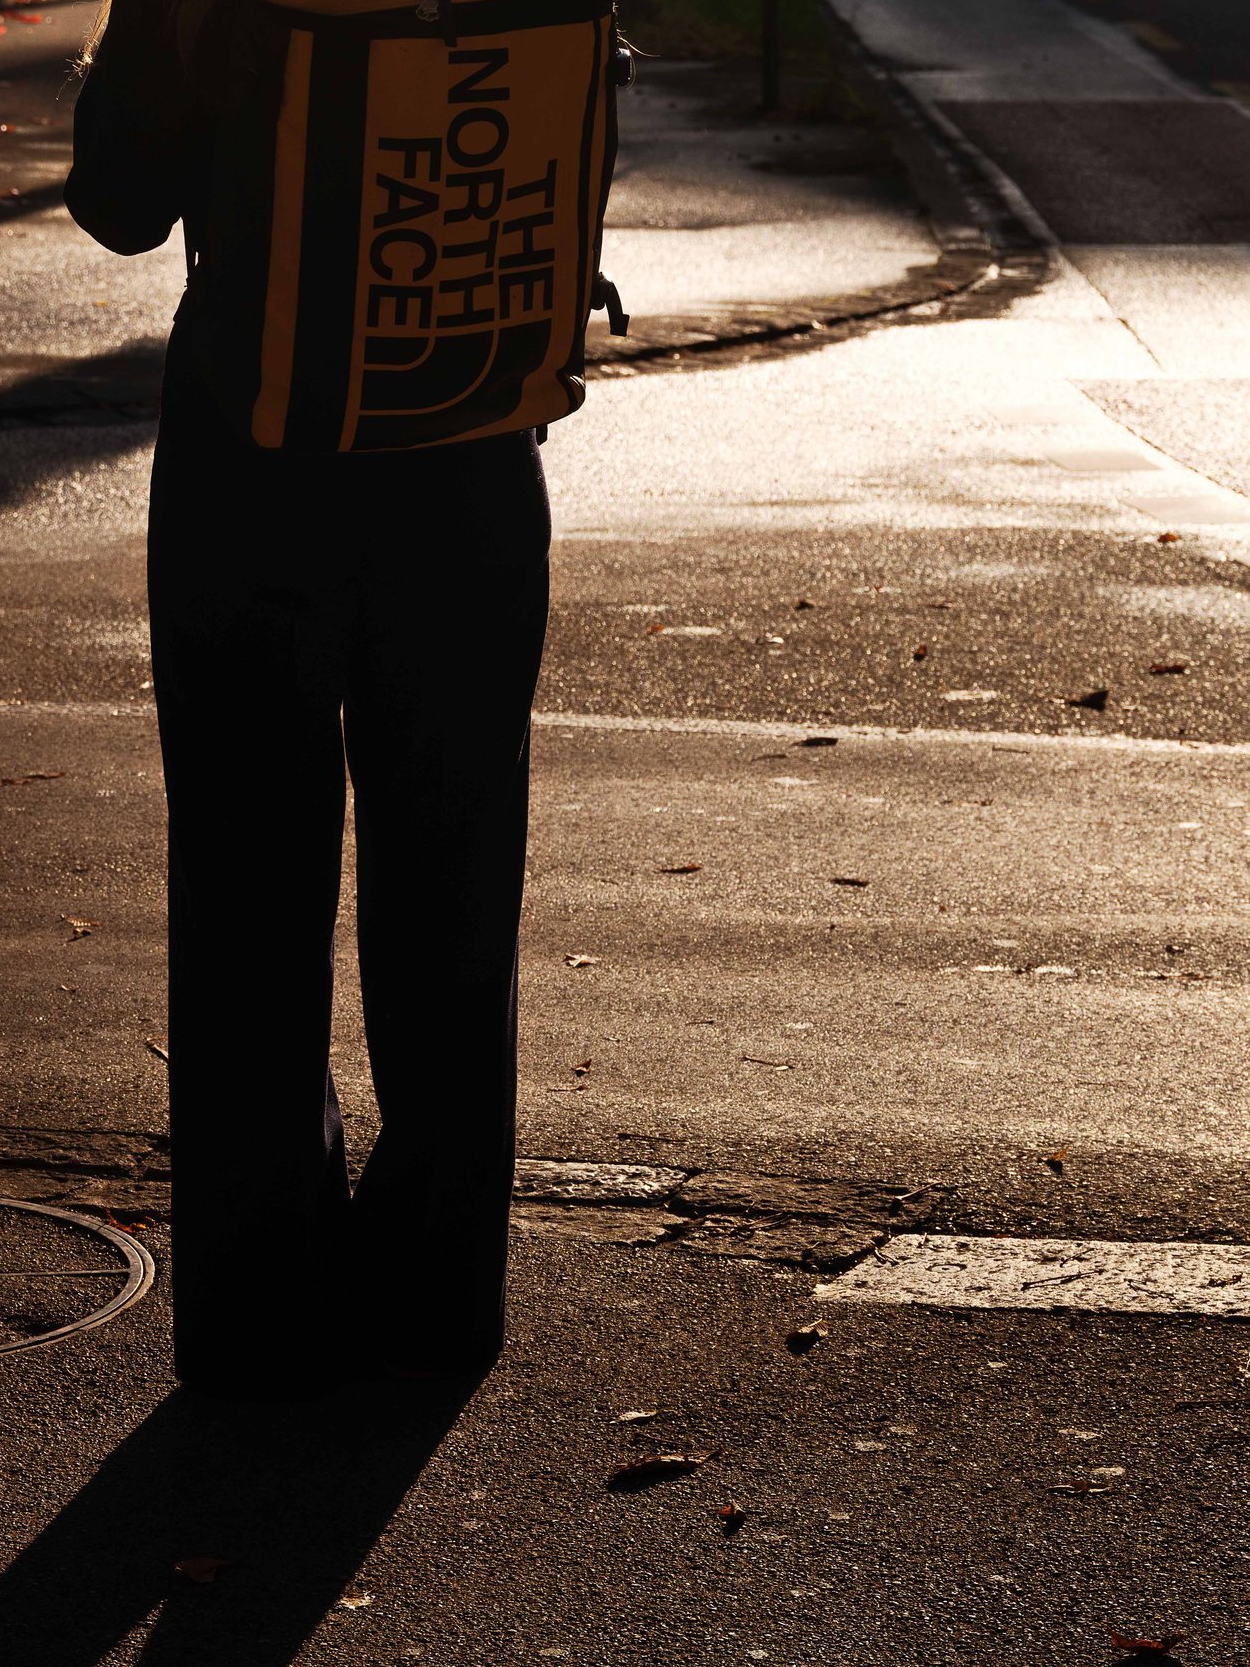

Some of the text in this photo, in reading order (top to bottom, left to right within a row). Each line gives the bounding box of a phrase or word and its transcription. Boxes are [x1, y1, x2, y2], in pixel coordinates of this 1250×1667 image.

[366, 137, 442, 328] FACE
[437, 48, 510, 328] NORTH
[498, 159, 558, 320] THE
